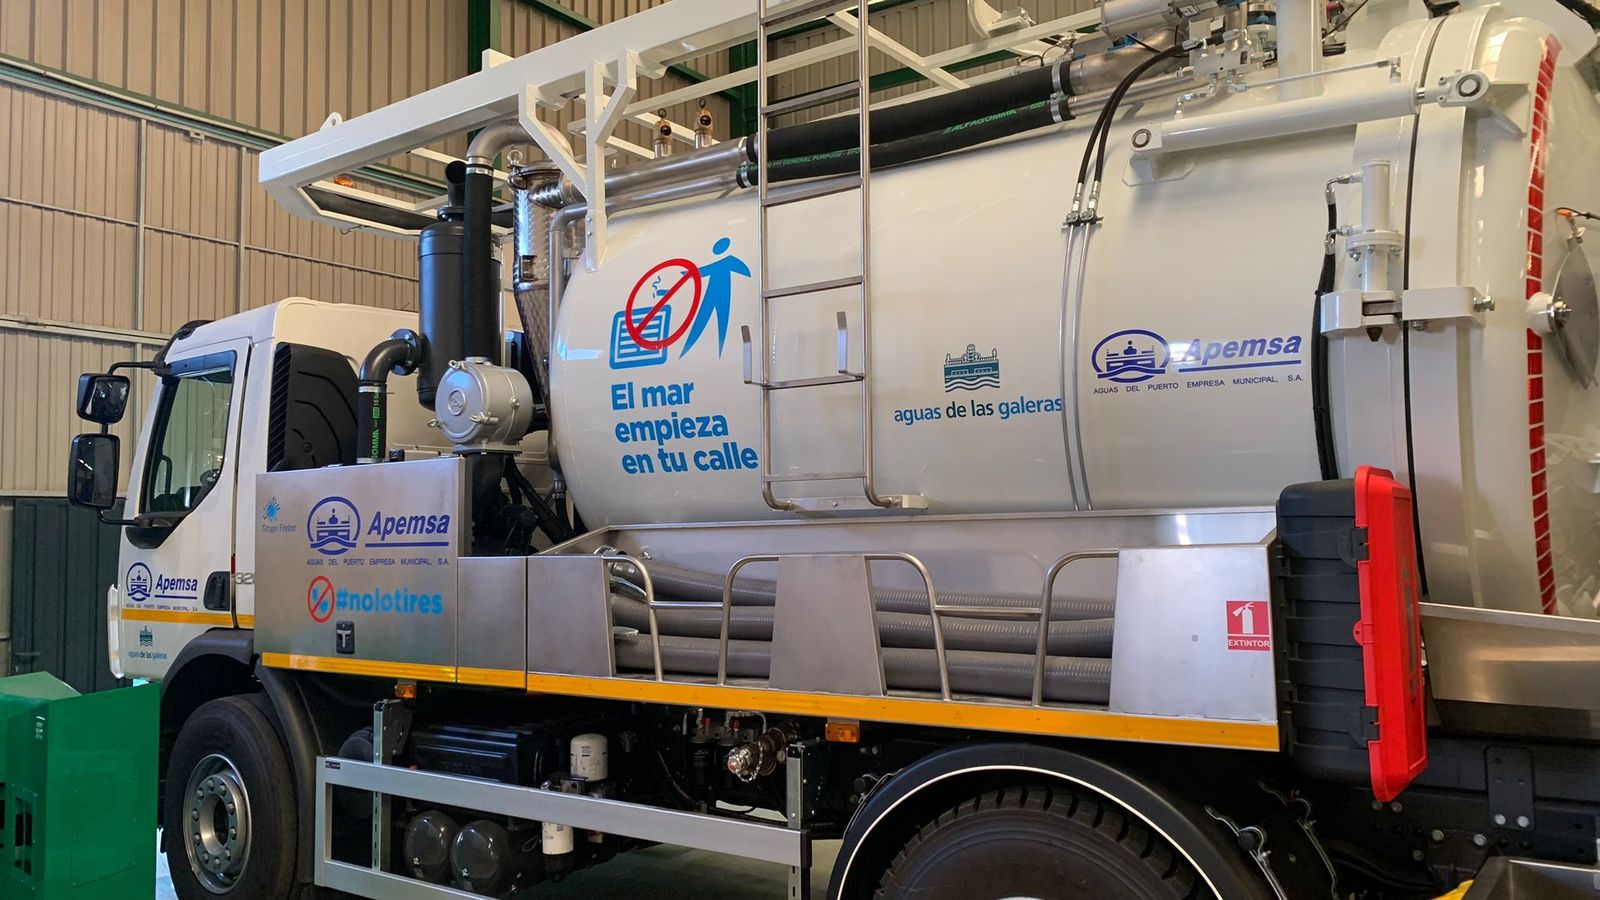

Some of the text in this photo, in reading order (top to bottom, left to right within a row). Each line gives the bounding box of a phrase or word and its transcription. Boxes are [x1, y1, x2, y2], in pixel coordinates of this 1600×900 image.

[1182, 335, 1302, 365] Apemsa
[611, 382, 694, 410] El mar
[1093, 386, 1119, 394] AGUAS
[1147, 382, 1179, 391] PUERTO
[1186, 379, 1225, 388] EMPRESA
[1287, 374, 1304, 382] S.A.
[894, 396, 1063, 425] aguas de las galeras
[615, 412, 729, 445] empieza
[622, 442, 759, 474] en tu calle
[367, 511, 450, 541] Apemsa
[328, 558, 338, 566] DEL
[343, 558, 365, 566] PUERTO
[369, 558, 396, 566] EMPRESA
[155, 573, 198, 594] Apemsa
[336, 587, 443, 615] #nolotires
[1228, 639, 1270, 648] EXTINTOR
